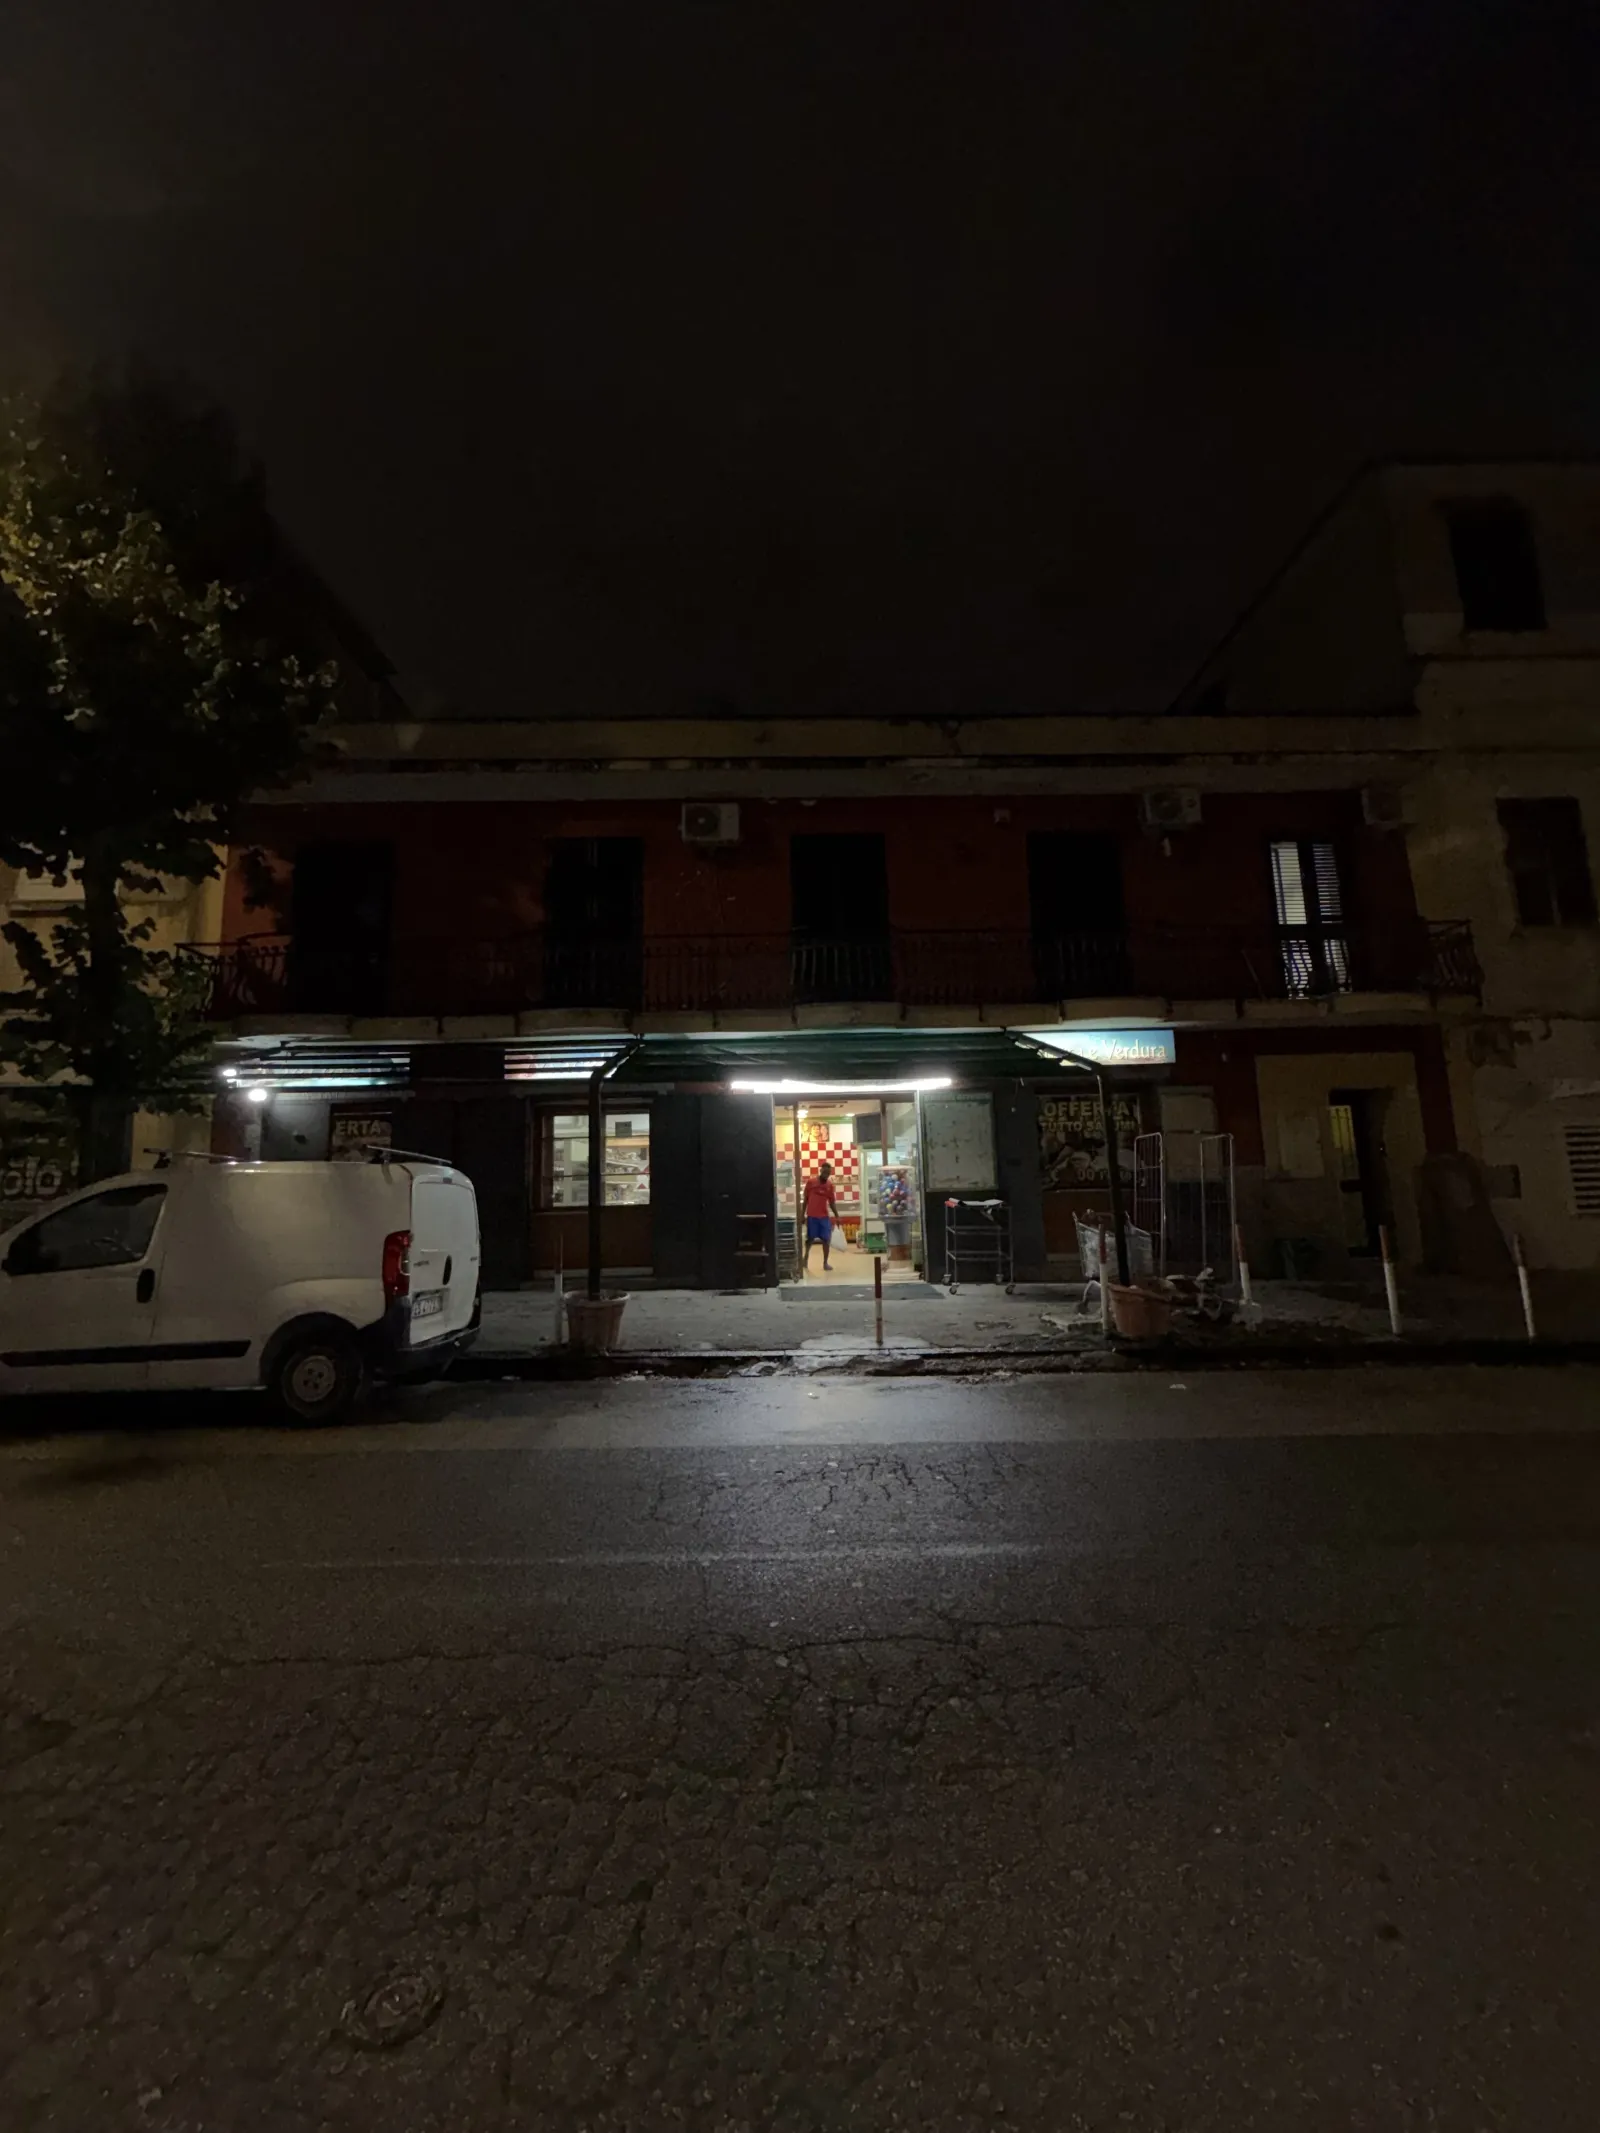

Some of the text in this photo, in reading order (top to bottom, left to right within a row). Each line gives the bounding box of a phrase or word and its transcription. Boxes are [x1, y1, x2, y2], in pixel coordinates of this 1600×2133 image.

[1101, 1038, 1166, 1061] Verdura
[1043, 1100, 1131, 1117] OFFERA
[1040, 1120, 1082, 1133] TUTTO
